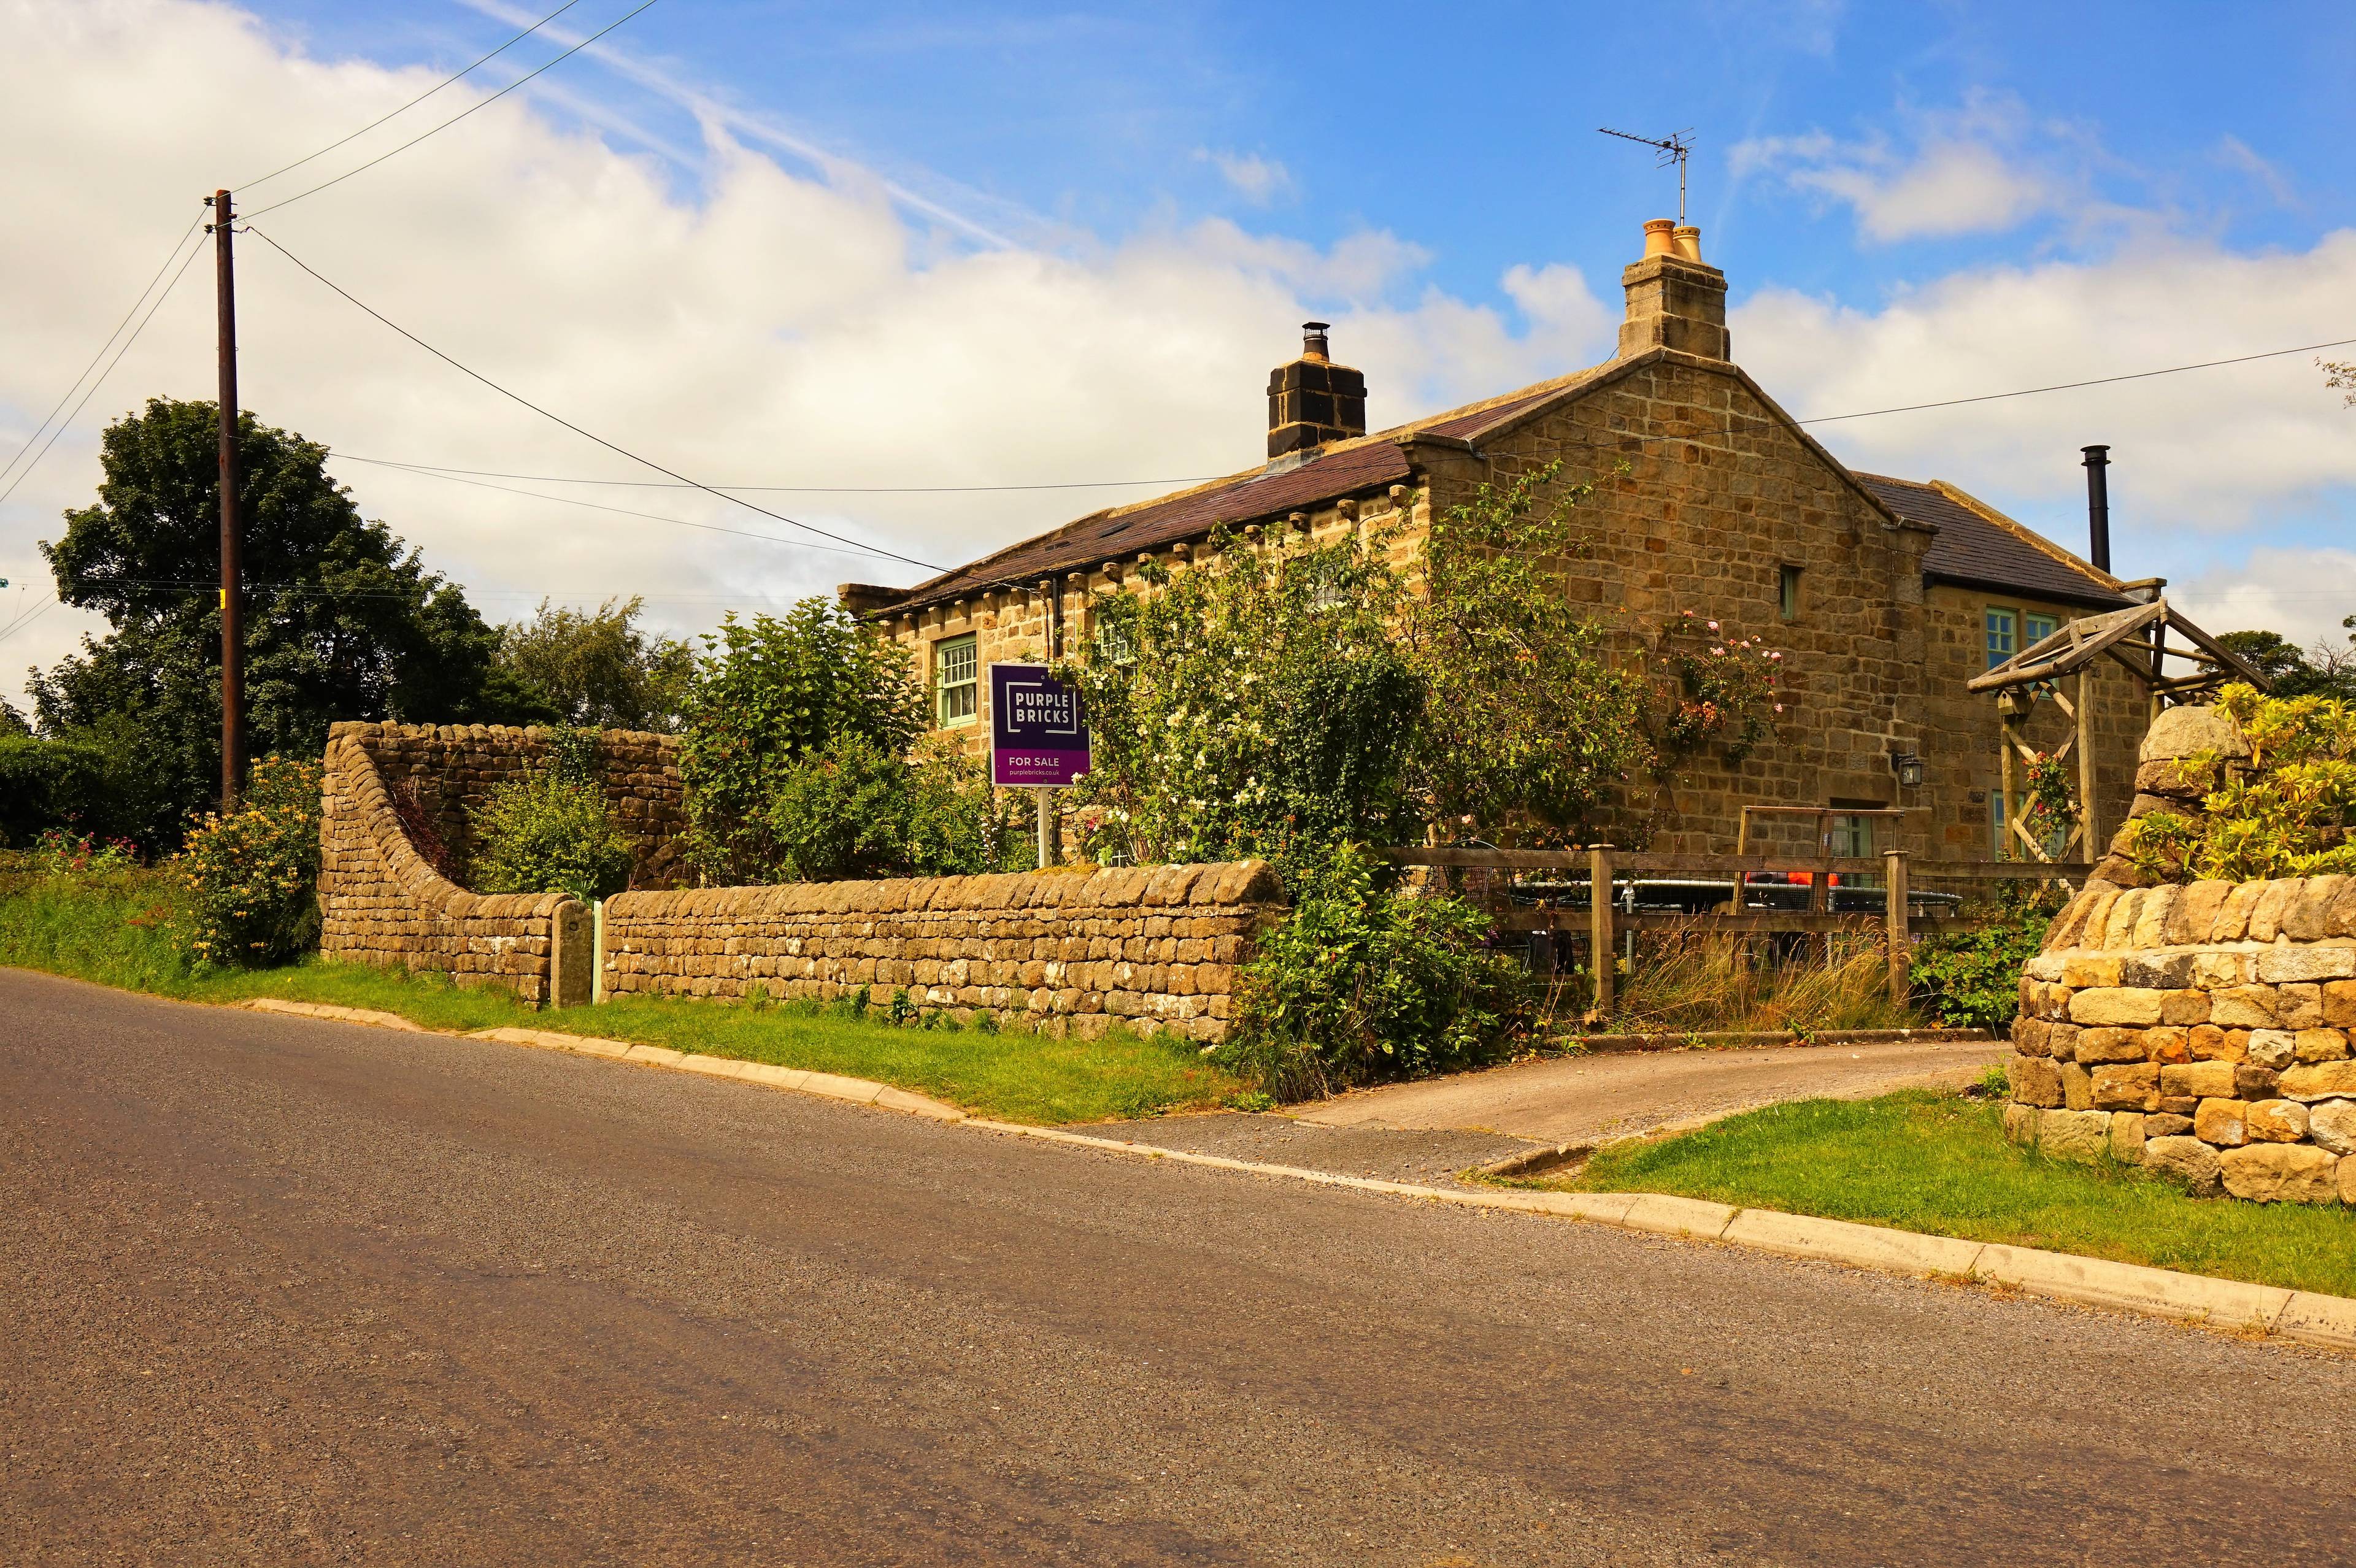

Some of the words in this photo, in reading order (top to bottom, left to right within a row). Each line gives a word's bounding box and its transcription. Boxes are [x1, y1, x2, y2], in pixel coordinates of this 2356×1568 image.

[1015, 693, 1068, 707] PURPLE
[1016, 709, 1069, 723] BRICKS
[1009, 757, 1031, 766] FOR
[1034, 757, 1060, 766] SALE
